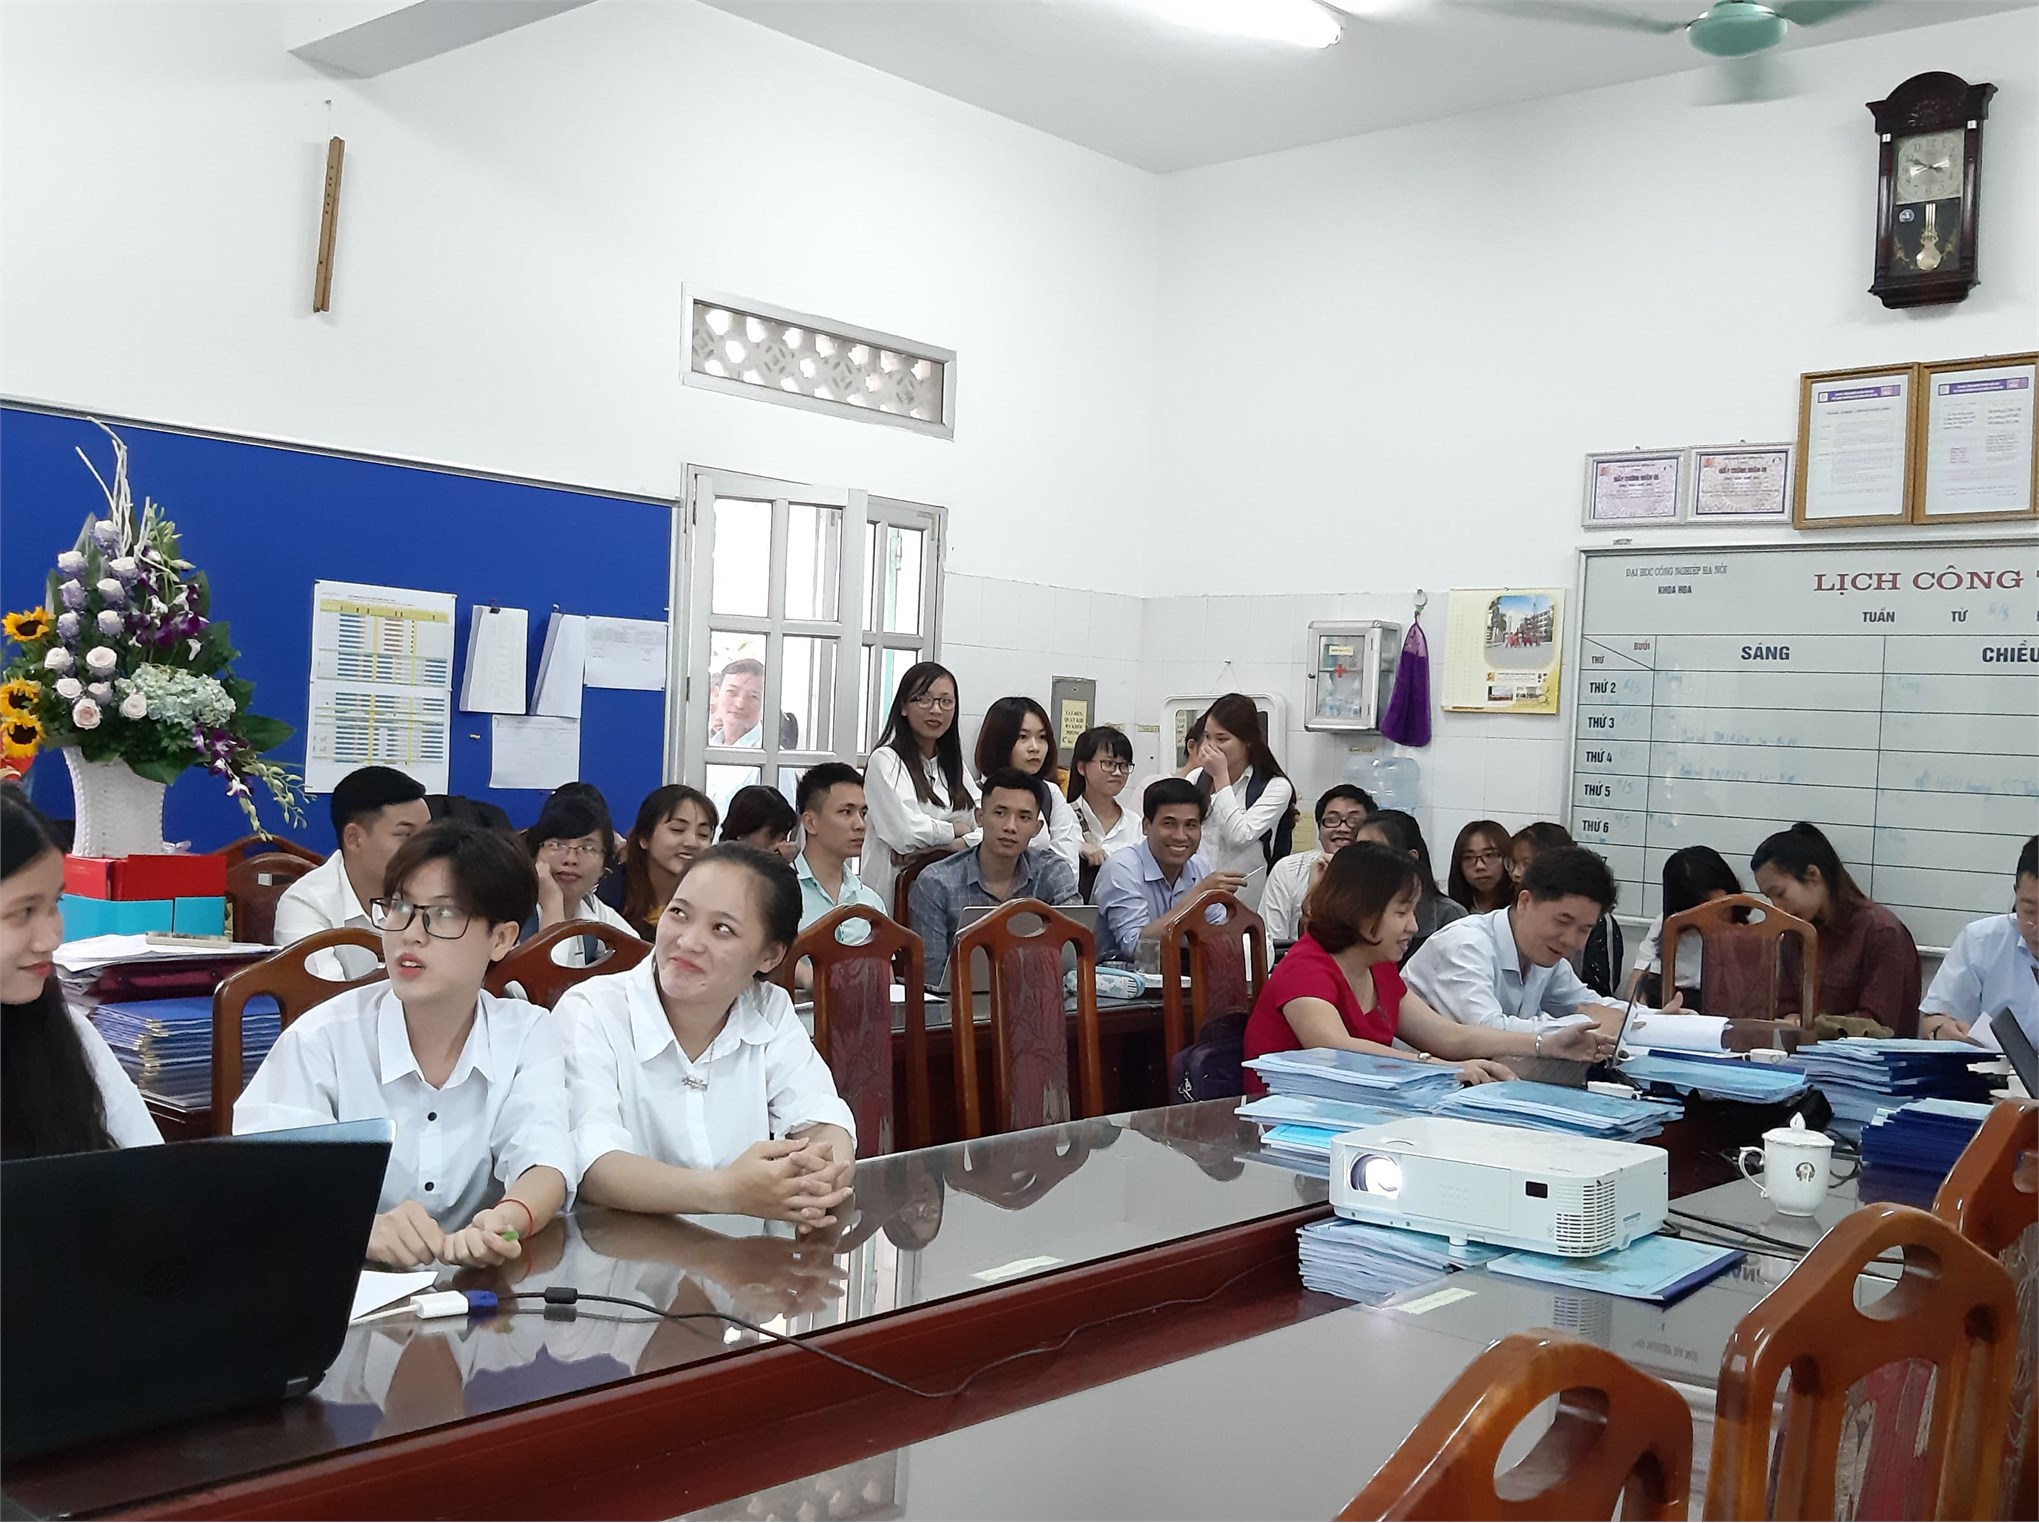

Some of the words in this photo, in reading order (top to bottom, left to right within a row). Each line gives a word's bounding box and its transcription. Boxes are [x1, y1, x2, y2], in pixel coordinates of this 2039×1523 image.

[1814, 572, 1901, 596] LỊCH
[1912, 564, 2024, 591] CÔNG
[1740, 642, 1790, 661] SÁNG
[1589, 678, 1609, 694] THỨ
[1610, 682, 1617, 694] 2
[1587, 712, 1608, 729] THỨ
[1608, 717, 1615, 729] 3
[1585, 748, 1606, 763] THỨ
[1606, 752, 1613, 763] 4
[1584, 781, 1604, 797] THỨ
[1604, 786, 1611, 797] 5
[1582, 817, 1602, 832] THỨ
[1603, 822, 1609, 833] 6
